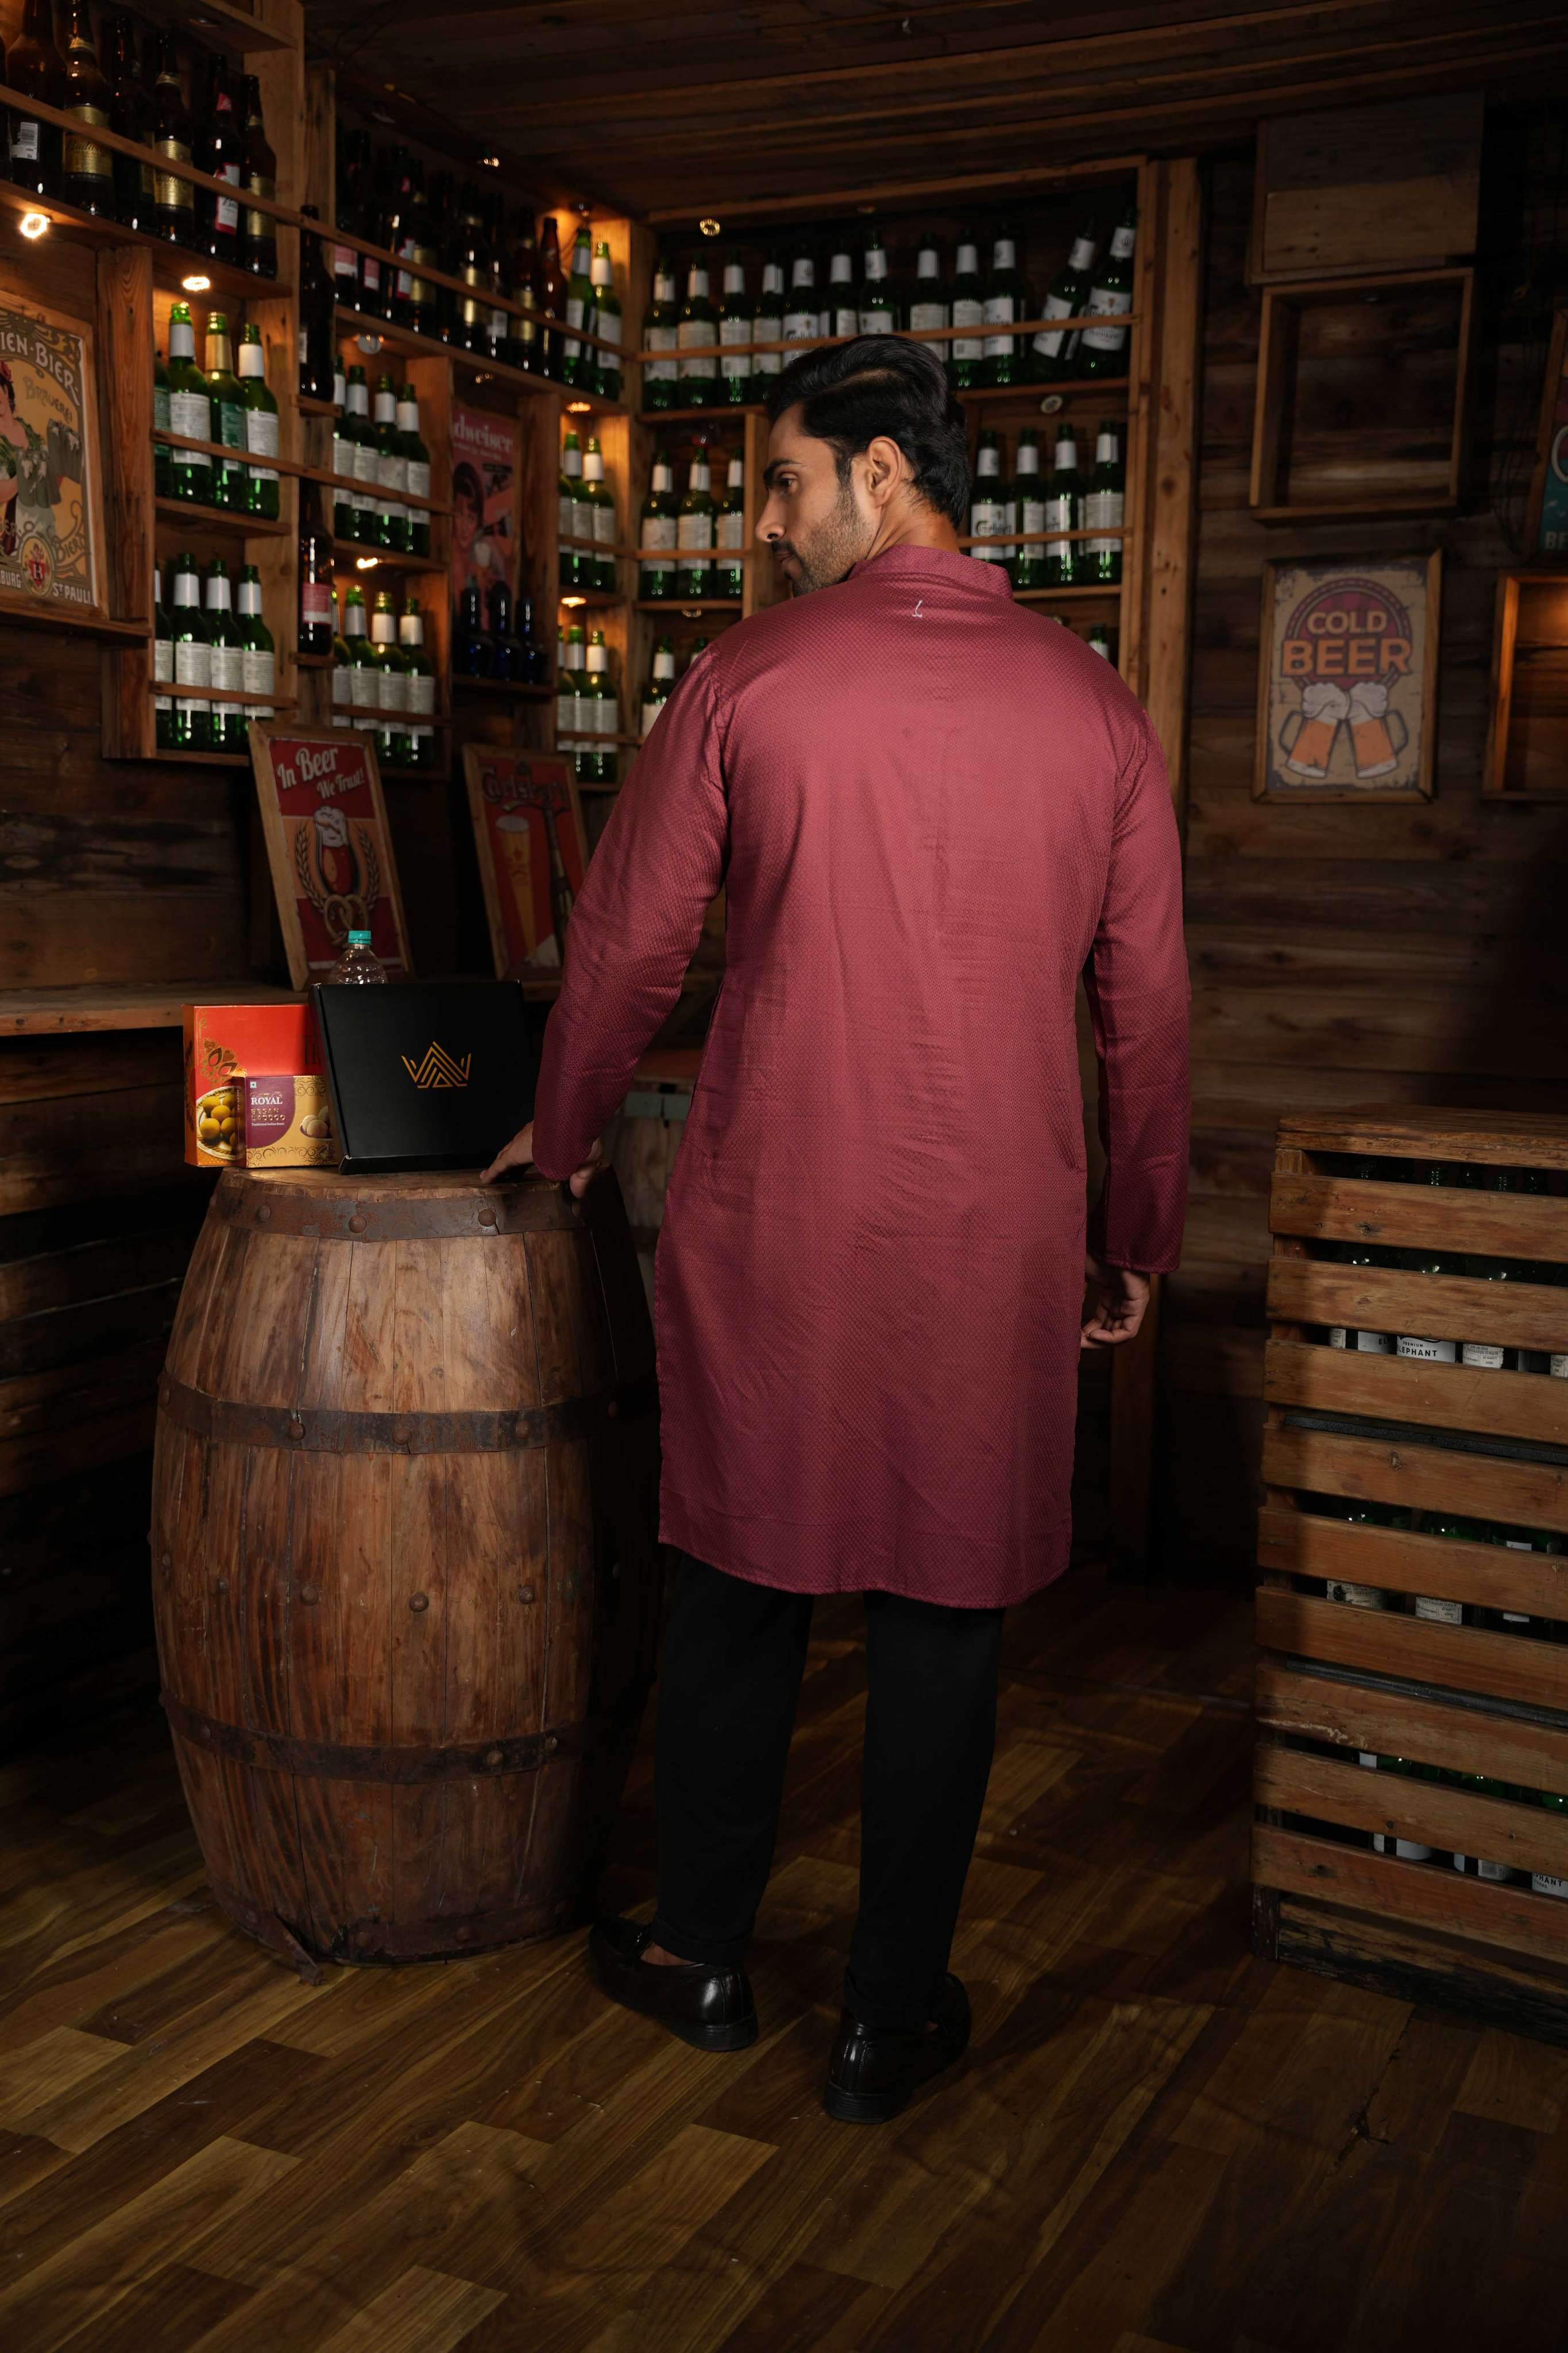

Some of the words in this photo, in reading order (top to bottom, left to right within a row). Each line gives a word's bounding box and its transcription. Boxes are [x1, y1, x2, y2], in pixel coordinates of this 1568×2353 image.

[454, 414, 514, 453] dweiser
[0, 570, 22, 589] BURG
[1307, 611, 1388, 635] COLD
[1282, 638, 1413, 676] BEER
[277, 763, 297, 790] In
[295, 747, 339, 782] Beer
[317, 779, 336, 800] We
[250, 1097, 283, 1105] ROYAL
[1397, 1345, 1437, 1356] ELEPHANT
